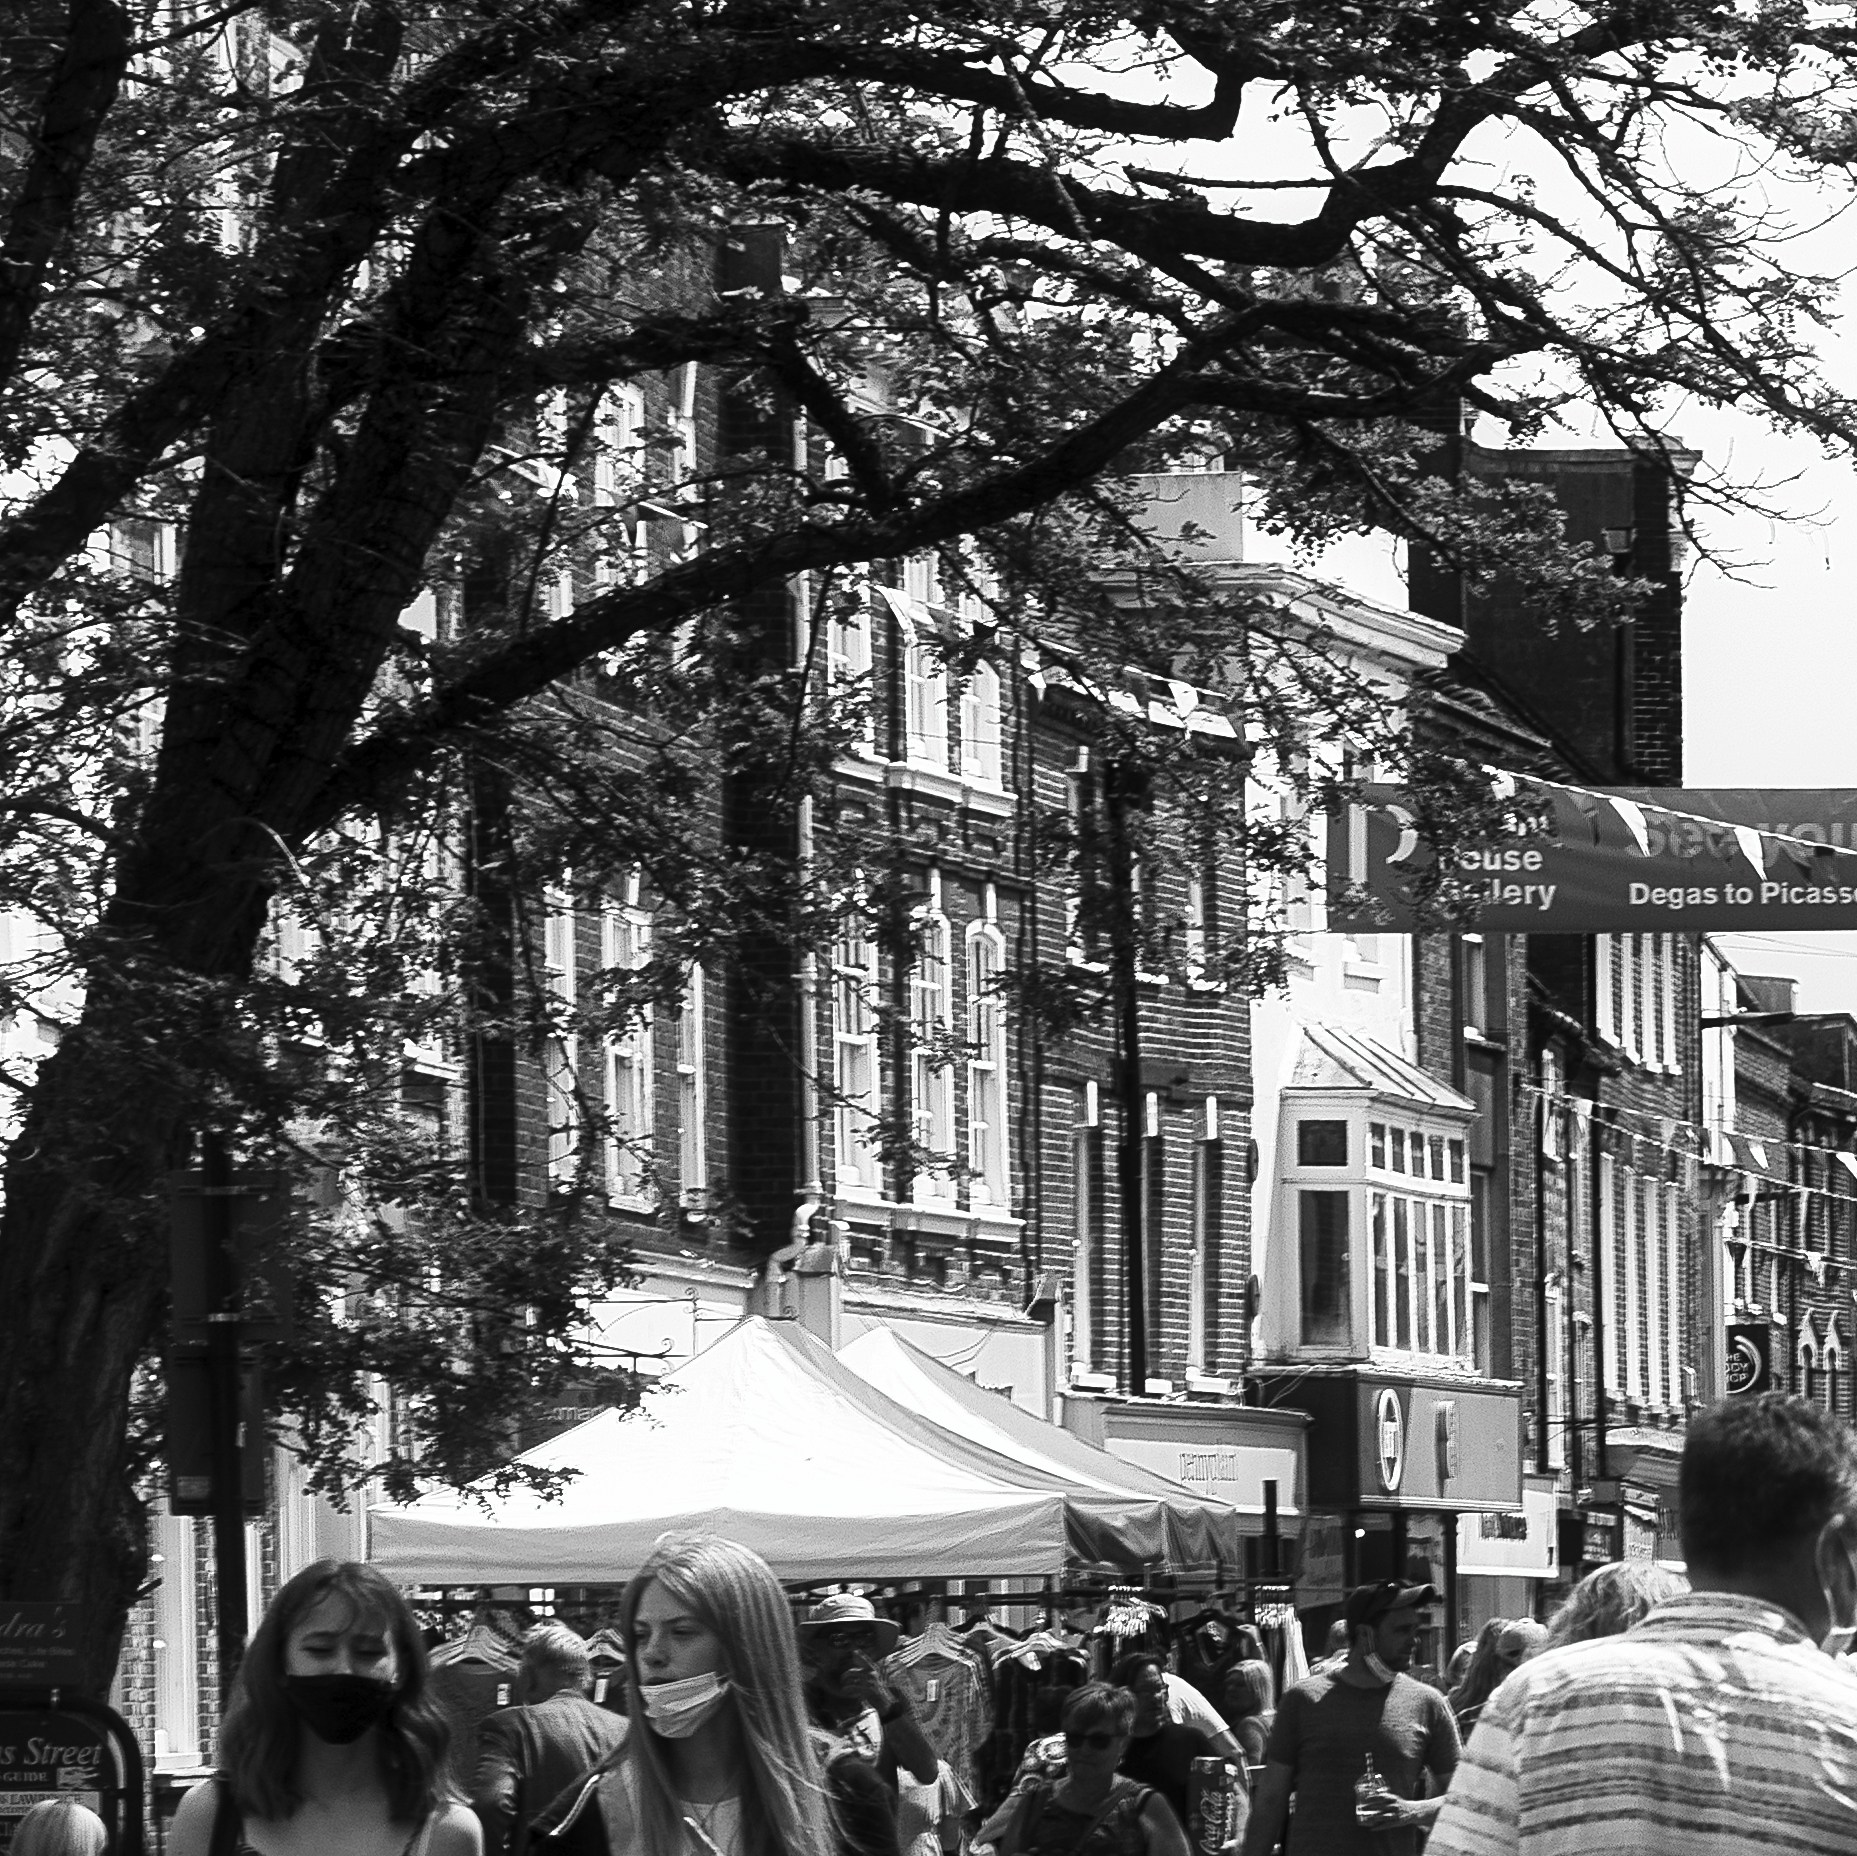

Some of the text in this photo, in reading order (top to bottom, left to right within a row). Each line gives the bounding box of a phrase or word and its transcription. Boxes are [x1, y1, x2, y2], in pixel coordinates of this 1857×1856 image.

[1629, 882, 1717, 911] Degas
[1723, 883, 1754, 905] to
[22, 1736, 102, 1766] Street
